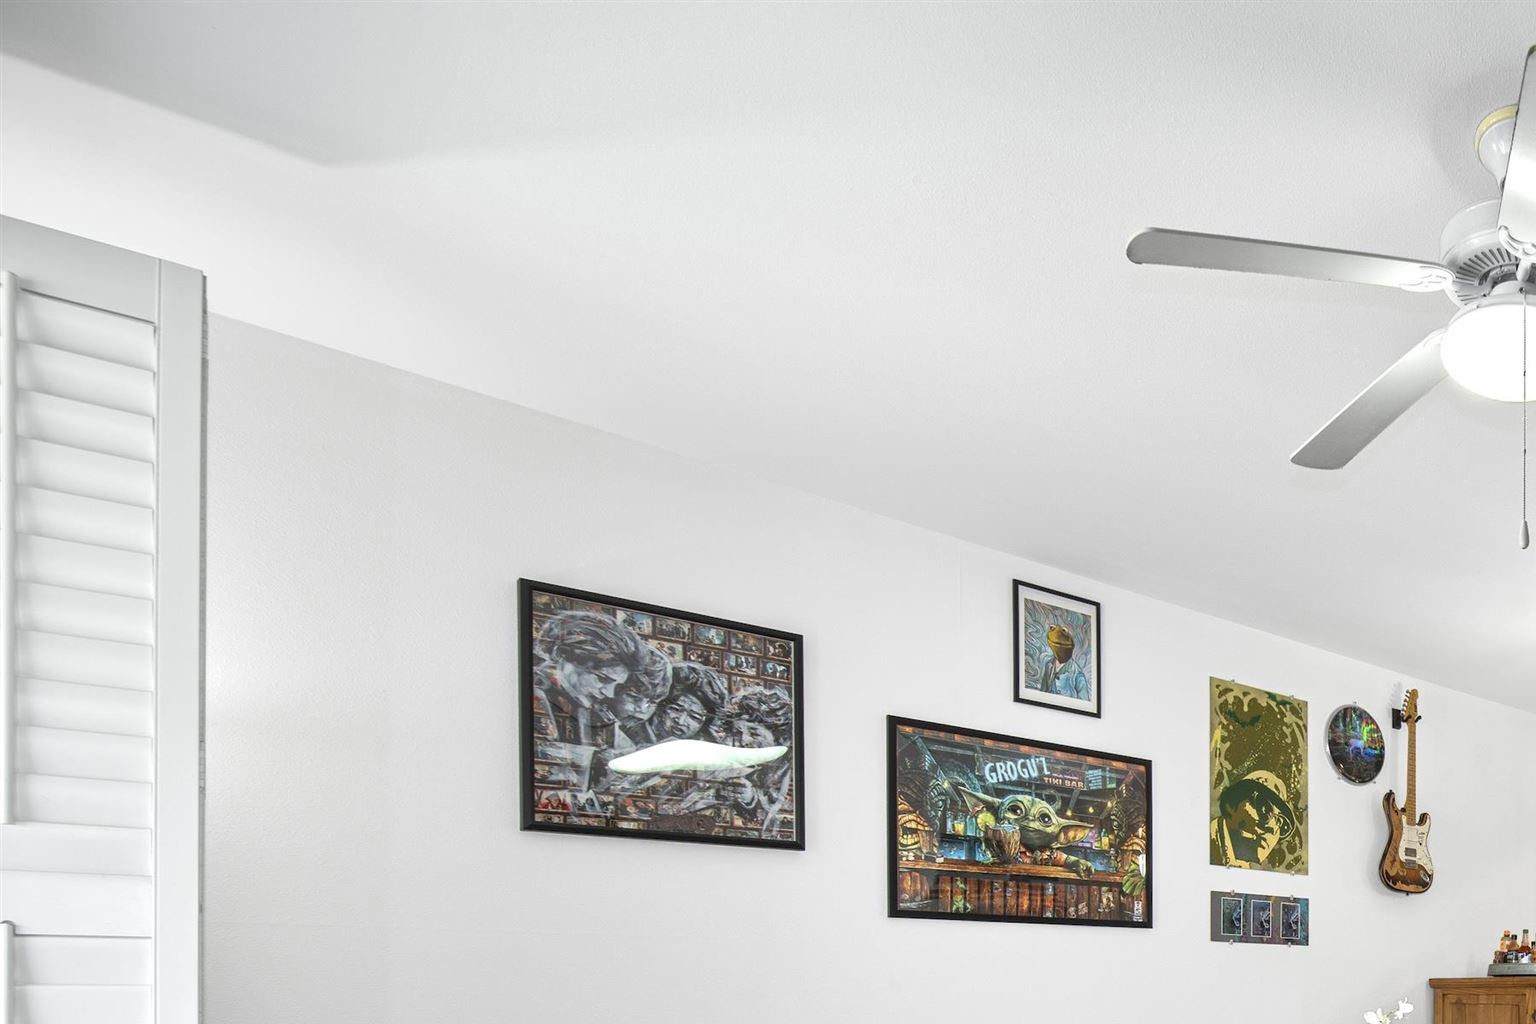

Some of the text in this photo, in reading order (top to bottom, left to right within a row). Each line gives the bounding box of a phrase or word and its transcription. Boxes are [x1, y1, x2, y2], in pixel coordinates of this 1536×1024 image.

[984, 757, 1051, 784] GROGU'Z
[1043, 777, 1084, 789] TIKI BAR
